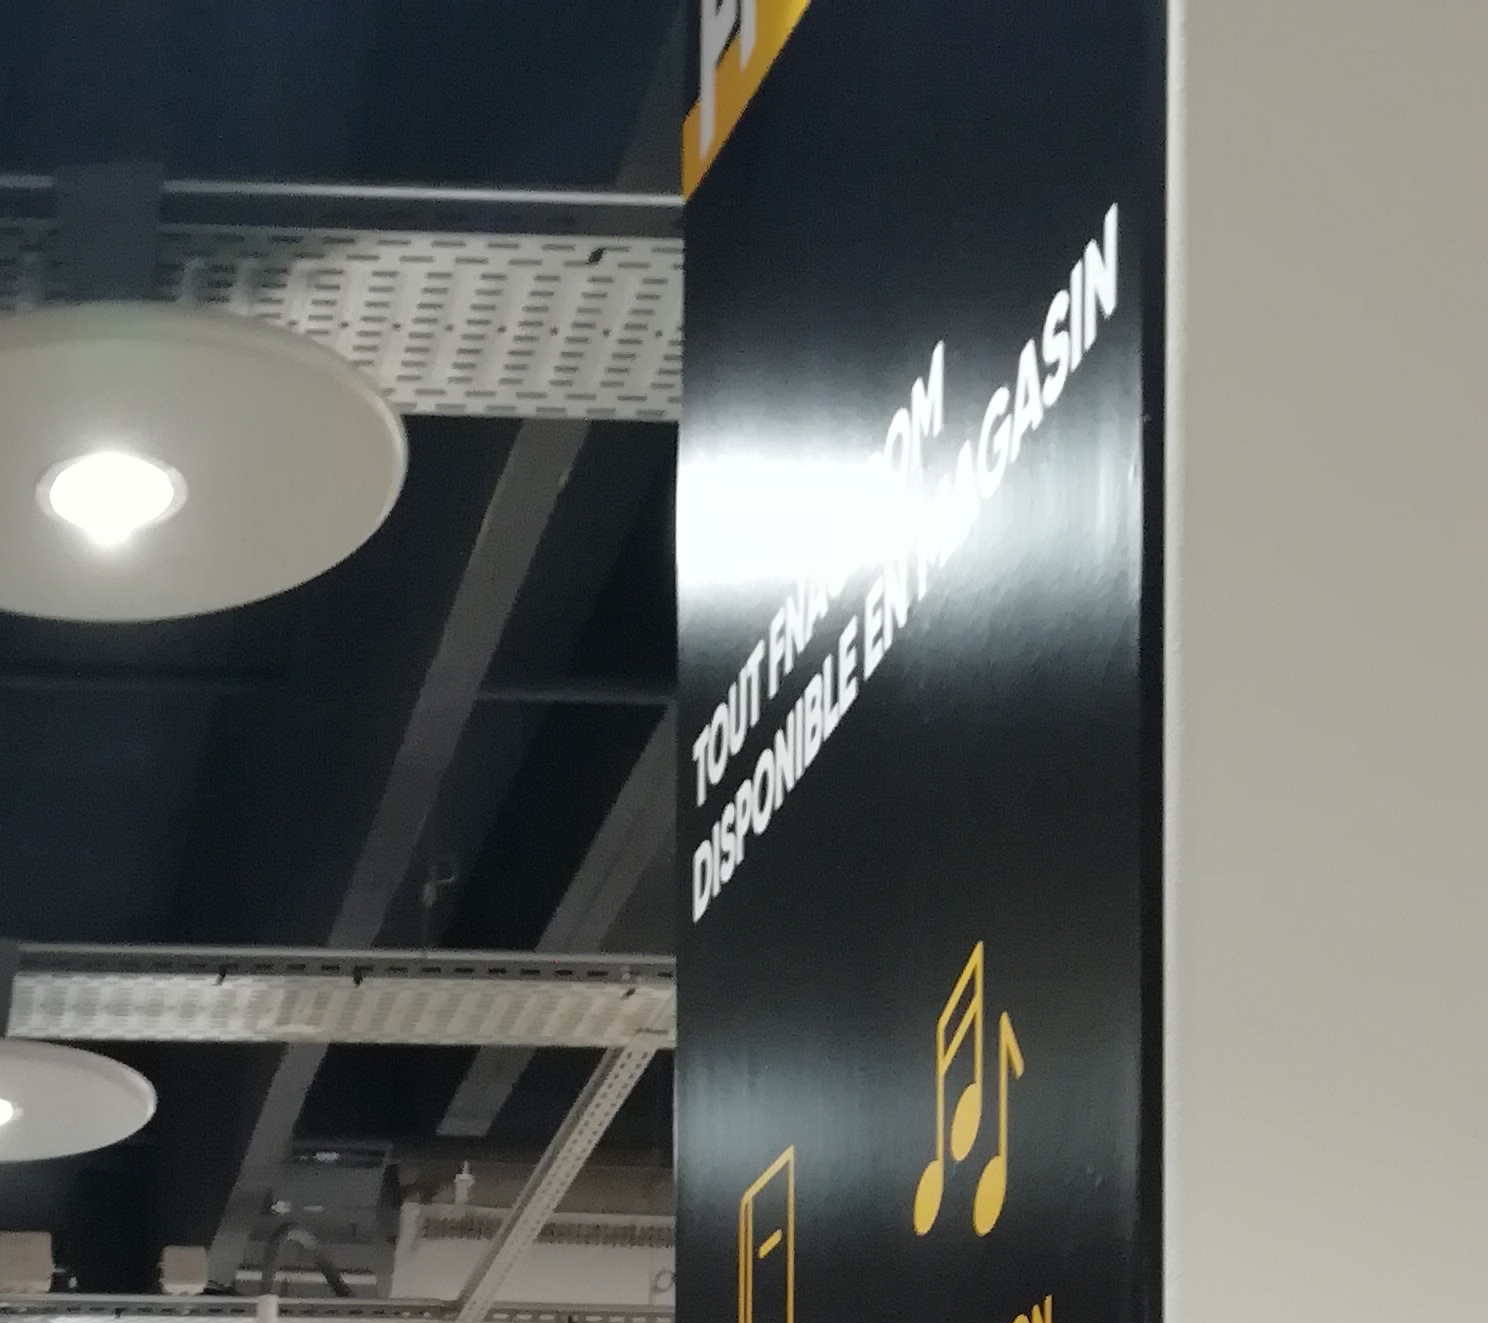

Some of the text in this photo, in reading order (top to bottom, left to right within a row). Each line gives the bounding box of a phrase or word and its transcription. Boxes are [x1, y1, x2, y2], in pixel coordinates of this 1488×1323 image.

[692, 614, 859, 923] DISPONIBLE
[864, 537, 911, 682] EN
[693, 640, 768, 807] TOUT
